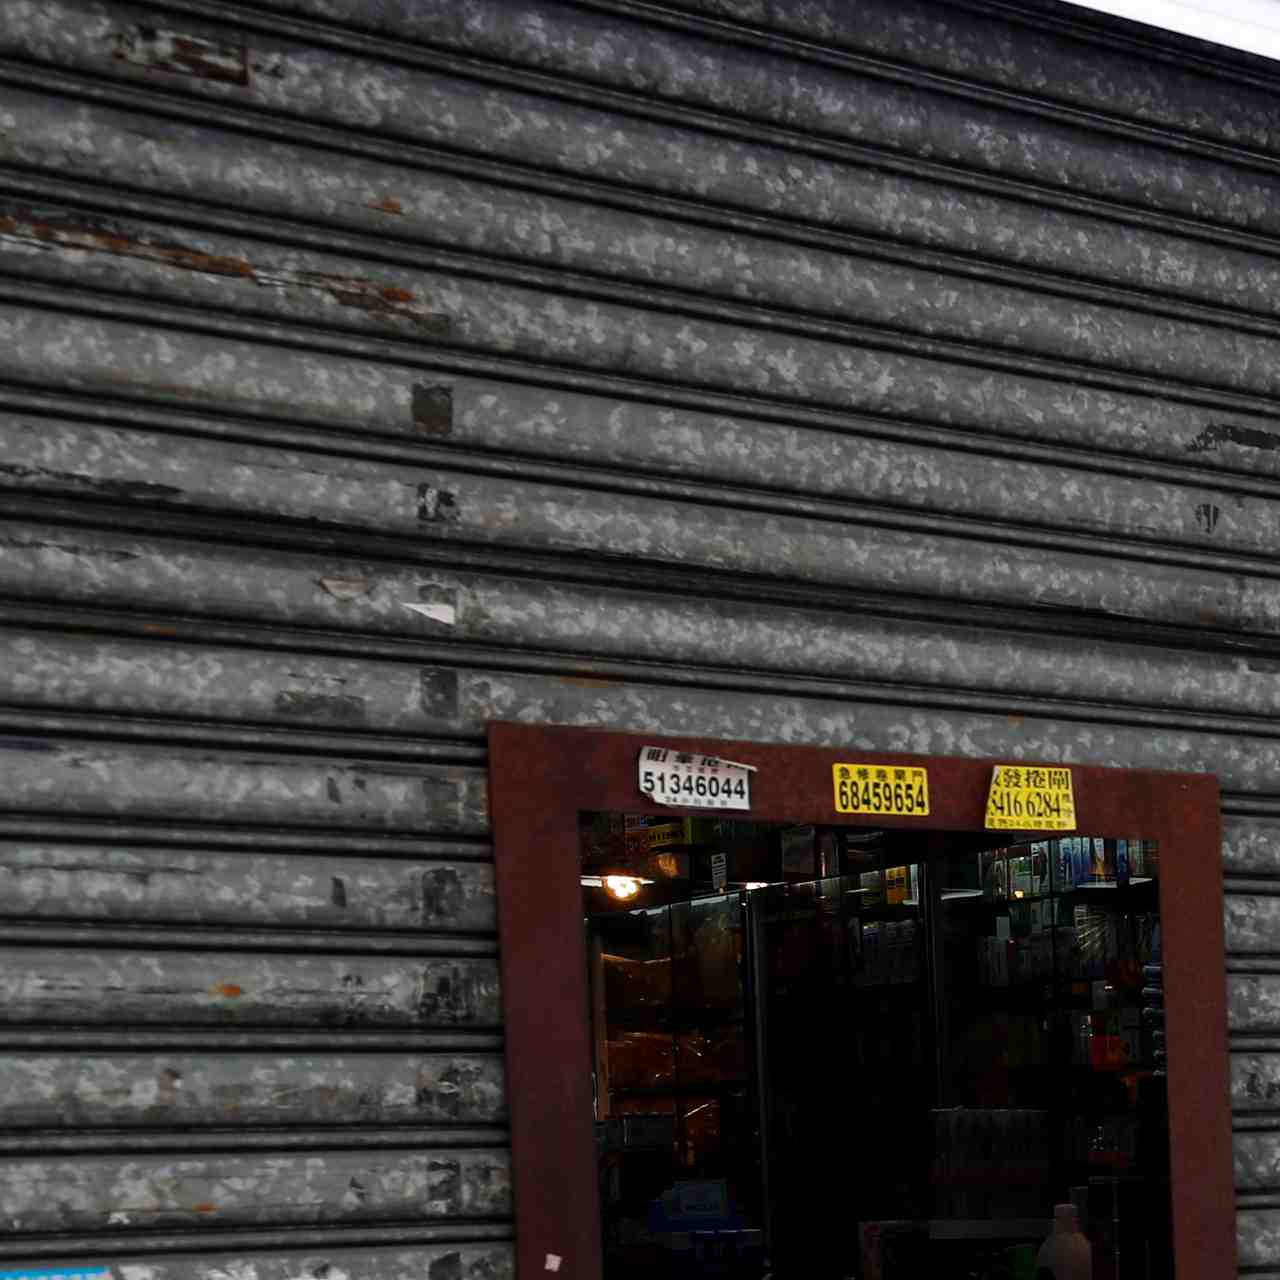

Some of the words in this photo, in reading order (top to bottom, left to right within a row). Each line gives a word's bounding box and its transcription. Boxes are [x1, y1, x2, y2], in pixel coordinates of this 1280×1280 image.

[643, 770, 746, 800] 51346044
[839, 780, 925, 813] 68459654
[1026, 791, 1061, 817] 6284
